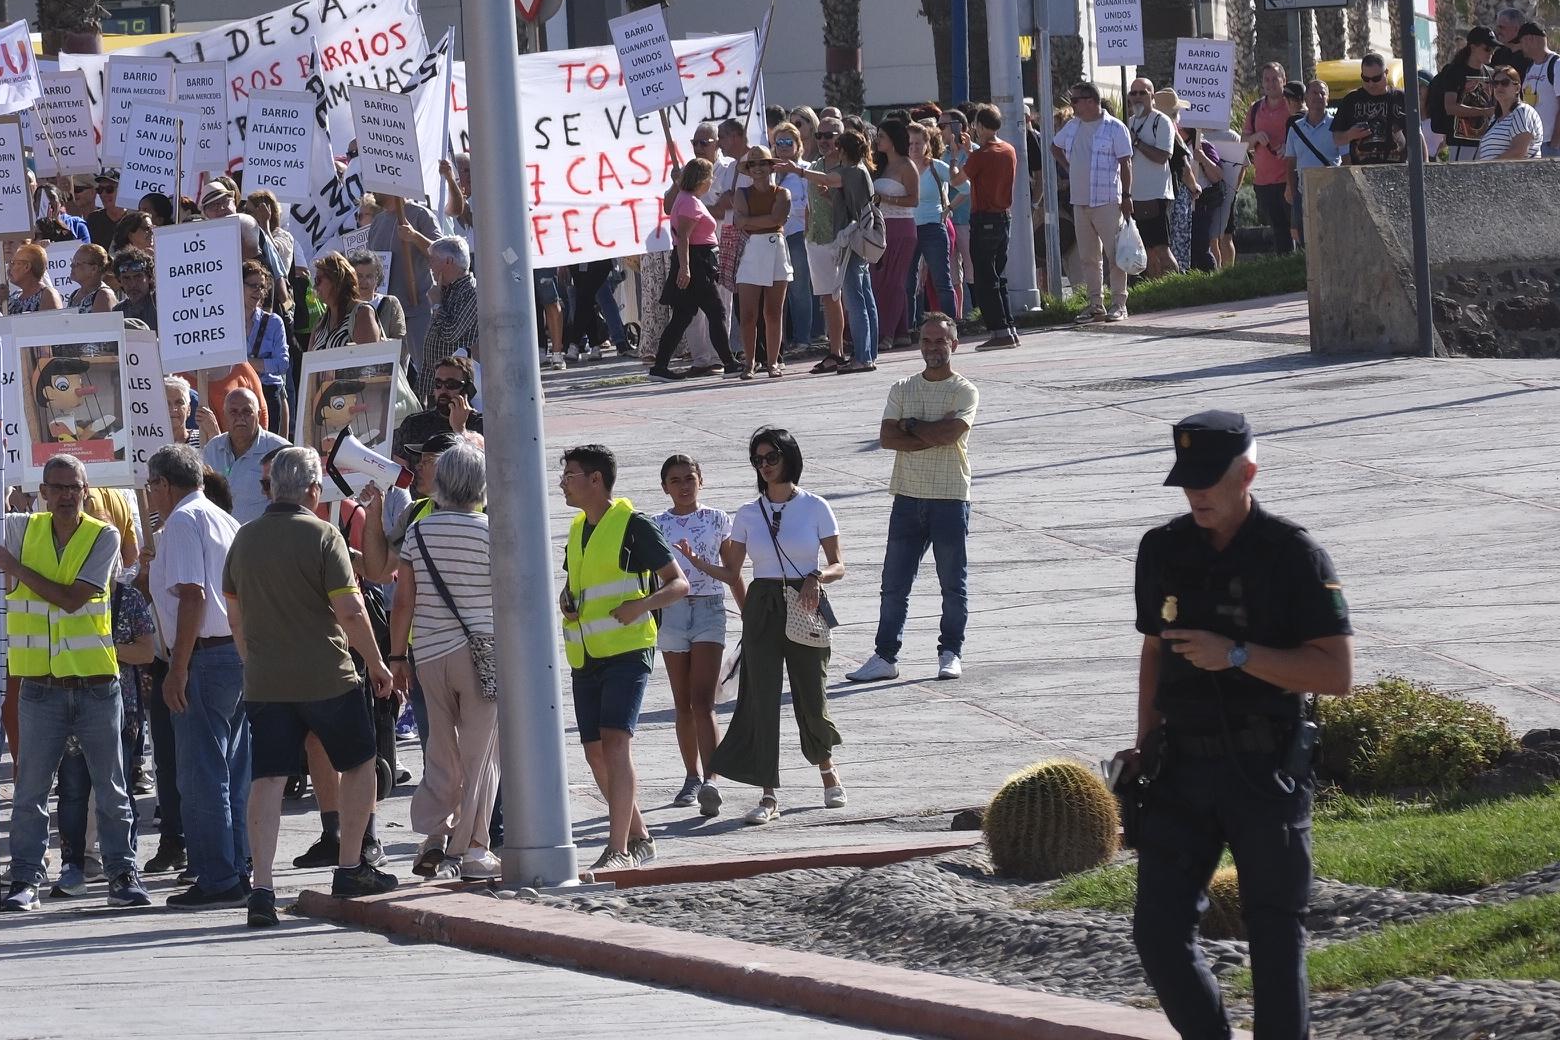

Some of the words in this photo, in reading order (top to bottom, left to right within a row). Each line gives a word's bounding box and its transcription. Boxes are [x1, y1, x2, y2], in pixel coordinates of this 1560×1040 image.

[1105, 11, 1131, 19] UNIDOS
[624, 24, 654, 39] BARRIO
[1099, 25, 1123, 33] SOMOS
[620, 34, 667, 56] GUANARTEME
[1107, 39, 1128, 48] LPGC
[631, 50, 662, 67] UNIDOS
[1188, 50, 1220, 58] BARRIO
[628, 68, 655, 84] SOMOS
[655, 62, 673, 76] MÁS
[1178, 62, 1228, 72] MARZAGÁN
[123, 72, 158, 82] BARRIO
[186, 77, 214, 87] BARRIO
[1186, 77, 1219, 86] UNIDOS
[112, 86, 132, 94] REINA
[133, 88, 166, 96] MERCEDES
[641, 82, 665, 97] LPGC
[1177, 89, 1206, 98] SOMOS
[1207, 89, 1225, 99] MÁS
[178, 93, 195, 101] REINA
[261, 107, 299, 120] BARRIO
[364, 100, 399, 114] BARRIO
[252, 122, 306, 137] ATLÁNTICO
[361, 114, 381, 126] SAN
[383, 118, 406, 131] JUAN
[535, 113, 581, 149] SE
[368, 131, 405, 146] UNIDOS
[258, 141, 297, 154] UNIDOS
[362, 145, 394, 159] SOMOS
[396, 151, 415, 164] MÁS
[248, 157, 282, 169] SOMOS
[284, 158, 305, 170] MÁS
[375, 163, 403, 177] LPGC
[257, 174, 287, 188] LPGC
[2, 185, 21, 195] MÁS
[183, 240, 206, 254] LOS
[169, 259, 224, 278] BARRIOS
[182, 283, 213, 299] LPGC
[172, 306, 199, 322] CON
[203, 304, 225, 319] LAS
[174, 327, 226, 345] TORRES
